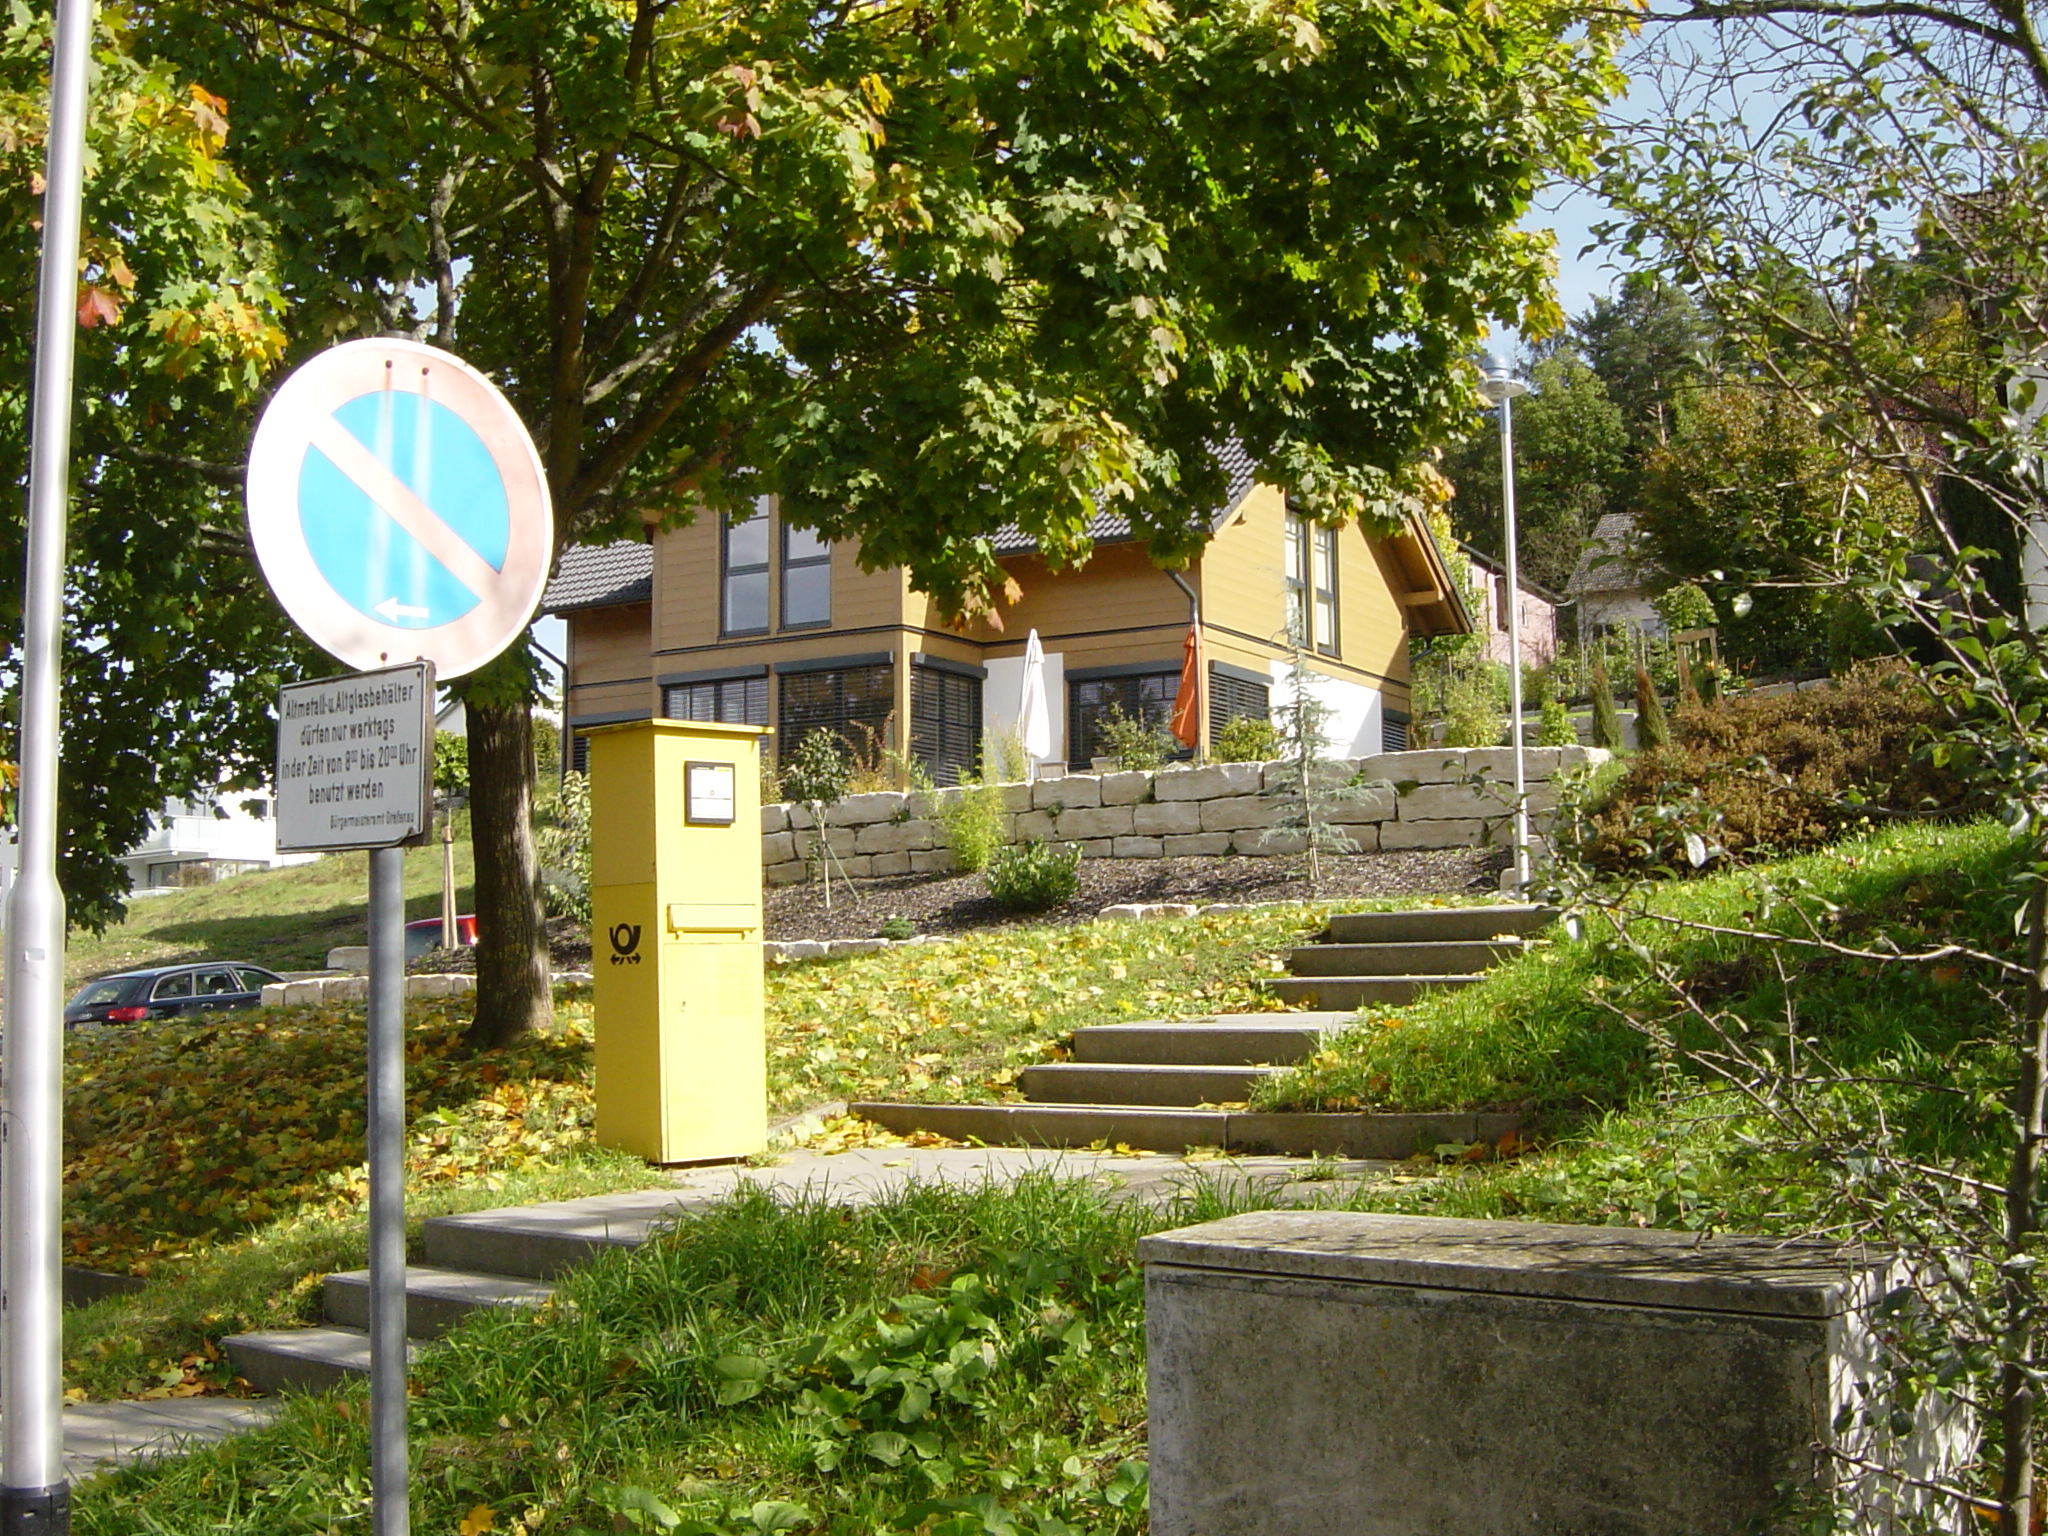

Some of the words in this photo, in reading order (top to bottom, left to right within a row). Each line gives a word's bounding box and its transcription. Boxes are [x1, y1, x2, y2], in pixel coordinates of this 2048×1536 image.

[300, 723, 330, 746] dürfen
[331, 724, 347, 743] nur
[349, 716, 395, 741] werktags
[281, 759, 290, 779] in
[290, 757, 306, 778] der
[307, 754, 324, 776] Zeit
[326, 757, 342, 775] von
[360, 748, 375, 770] bis
[399, 743, 417, 766] Uhr
[309, 782, 344, 804] benutzt
[346, 778, 384, 801] werden
